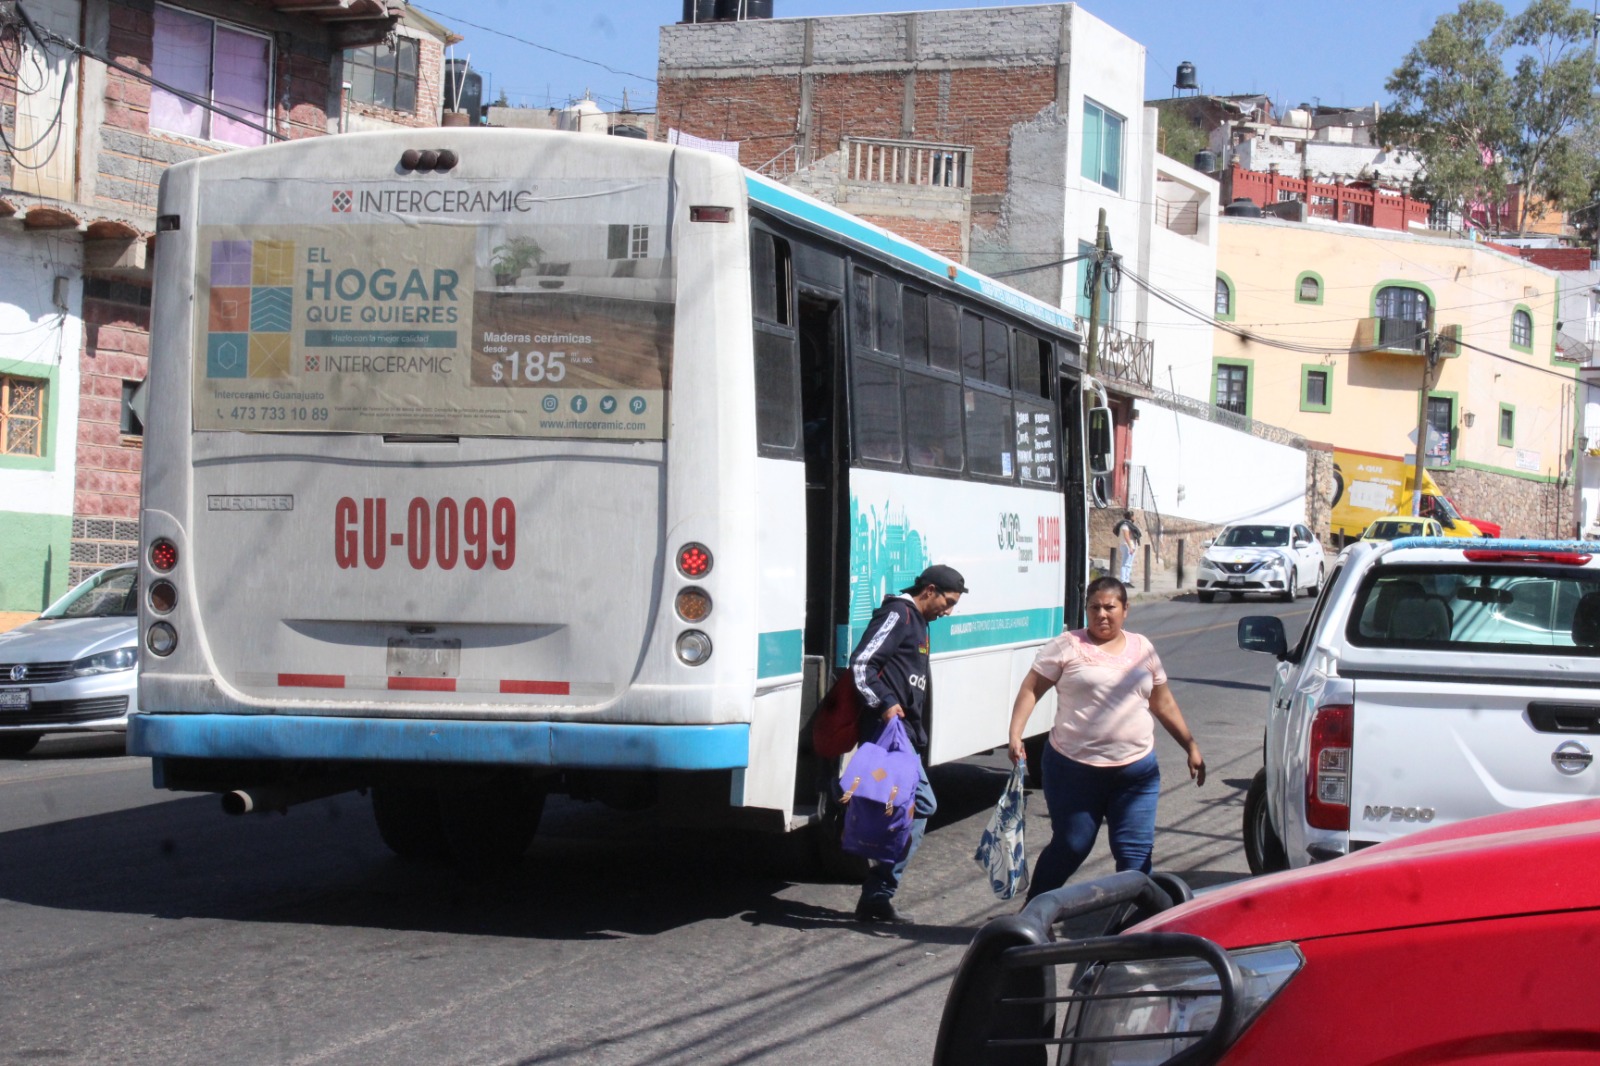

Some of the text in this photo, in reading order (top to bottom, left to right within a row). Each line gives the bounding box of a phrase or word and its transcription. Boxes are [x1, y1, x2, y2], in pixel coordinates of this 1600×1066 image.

[358, 190, 532, 213] INTERCERAMIC
[307, 247, 331, 263] EL
[305, 268, 459, 301] HOGAR
[306, 306, 458, 324] QUE QUIERES
[331, 334, 353, 343] Hazlo
[369, 334, 376, 343] la
[377, 335, 400, 344] mejor
[401, 334, 429, 343] calidad
[483, 332, 592, 344] Maderas cerámicas
[483, 345, 508, 353] desde
[324, 356, 452, 374] INTERCERAMIC
[491, 351, 566, 383] $185
[214, 390, 325, 402] Interceramic Guanajuato
[230, 406, 257, 420] 473
[260, 406, 286, 421] 733
[291, 407, 307, 421] 10
[311, 407, 328, 421] 89
[539, 419, 646, 430] www.interceramic.com
[334, 496, 516, 571] GU-0099
